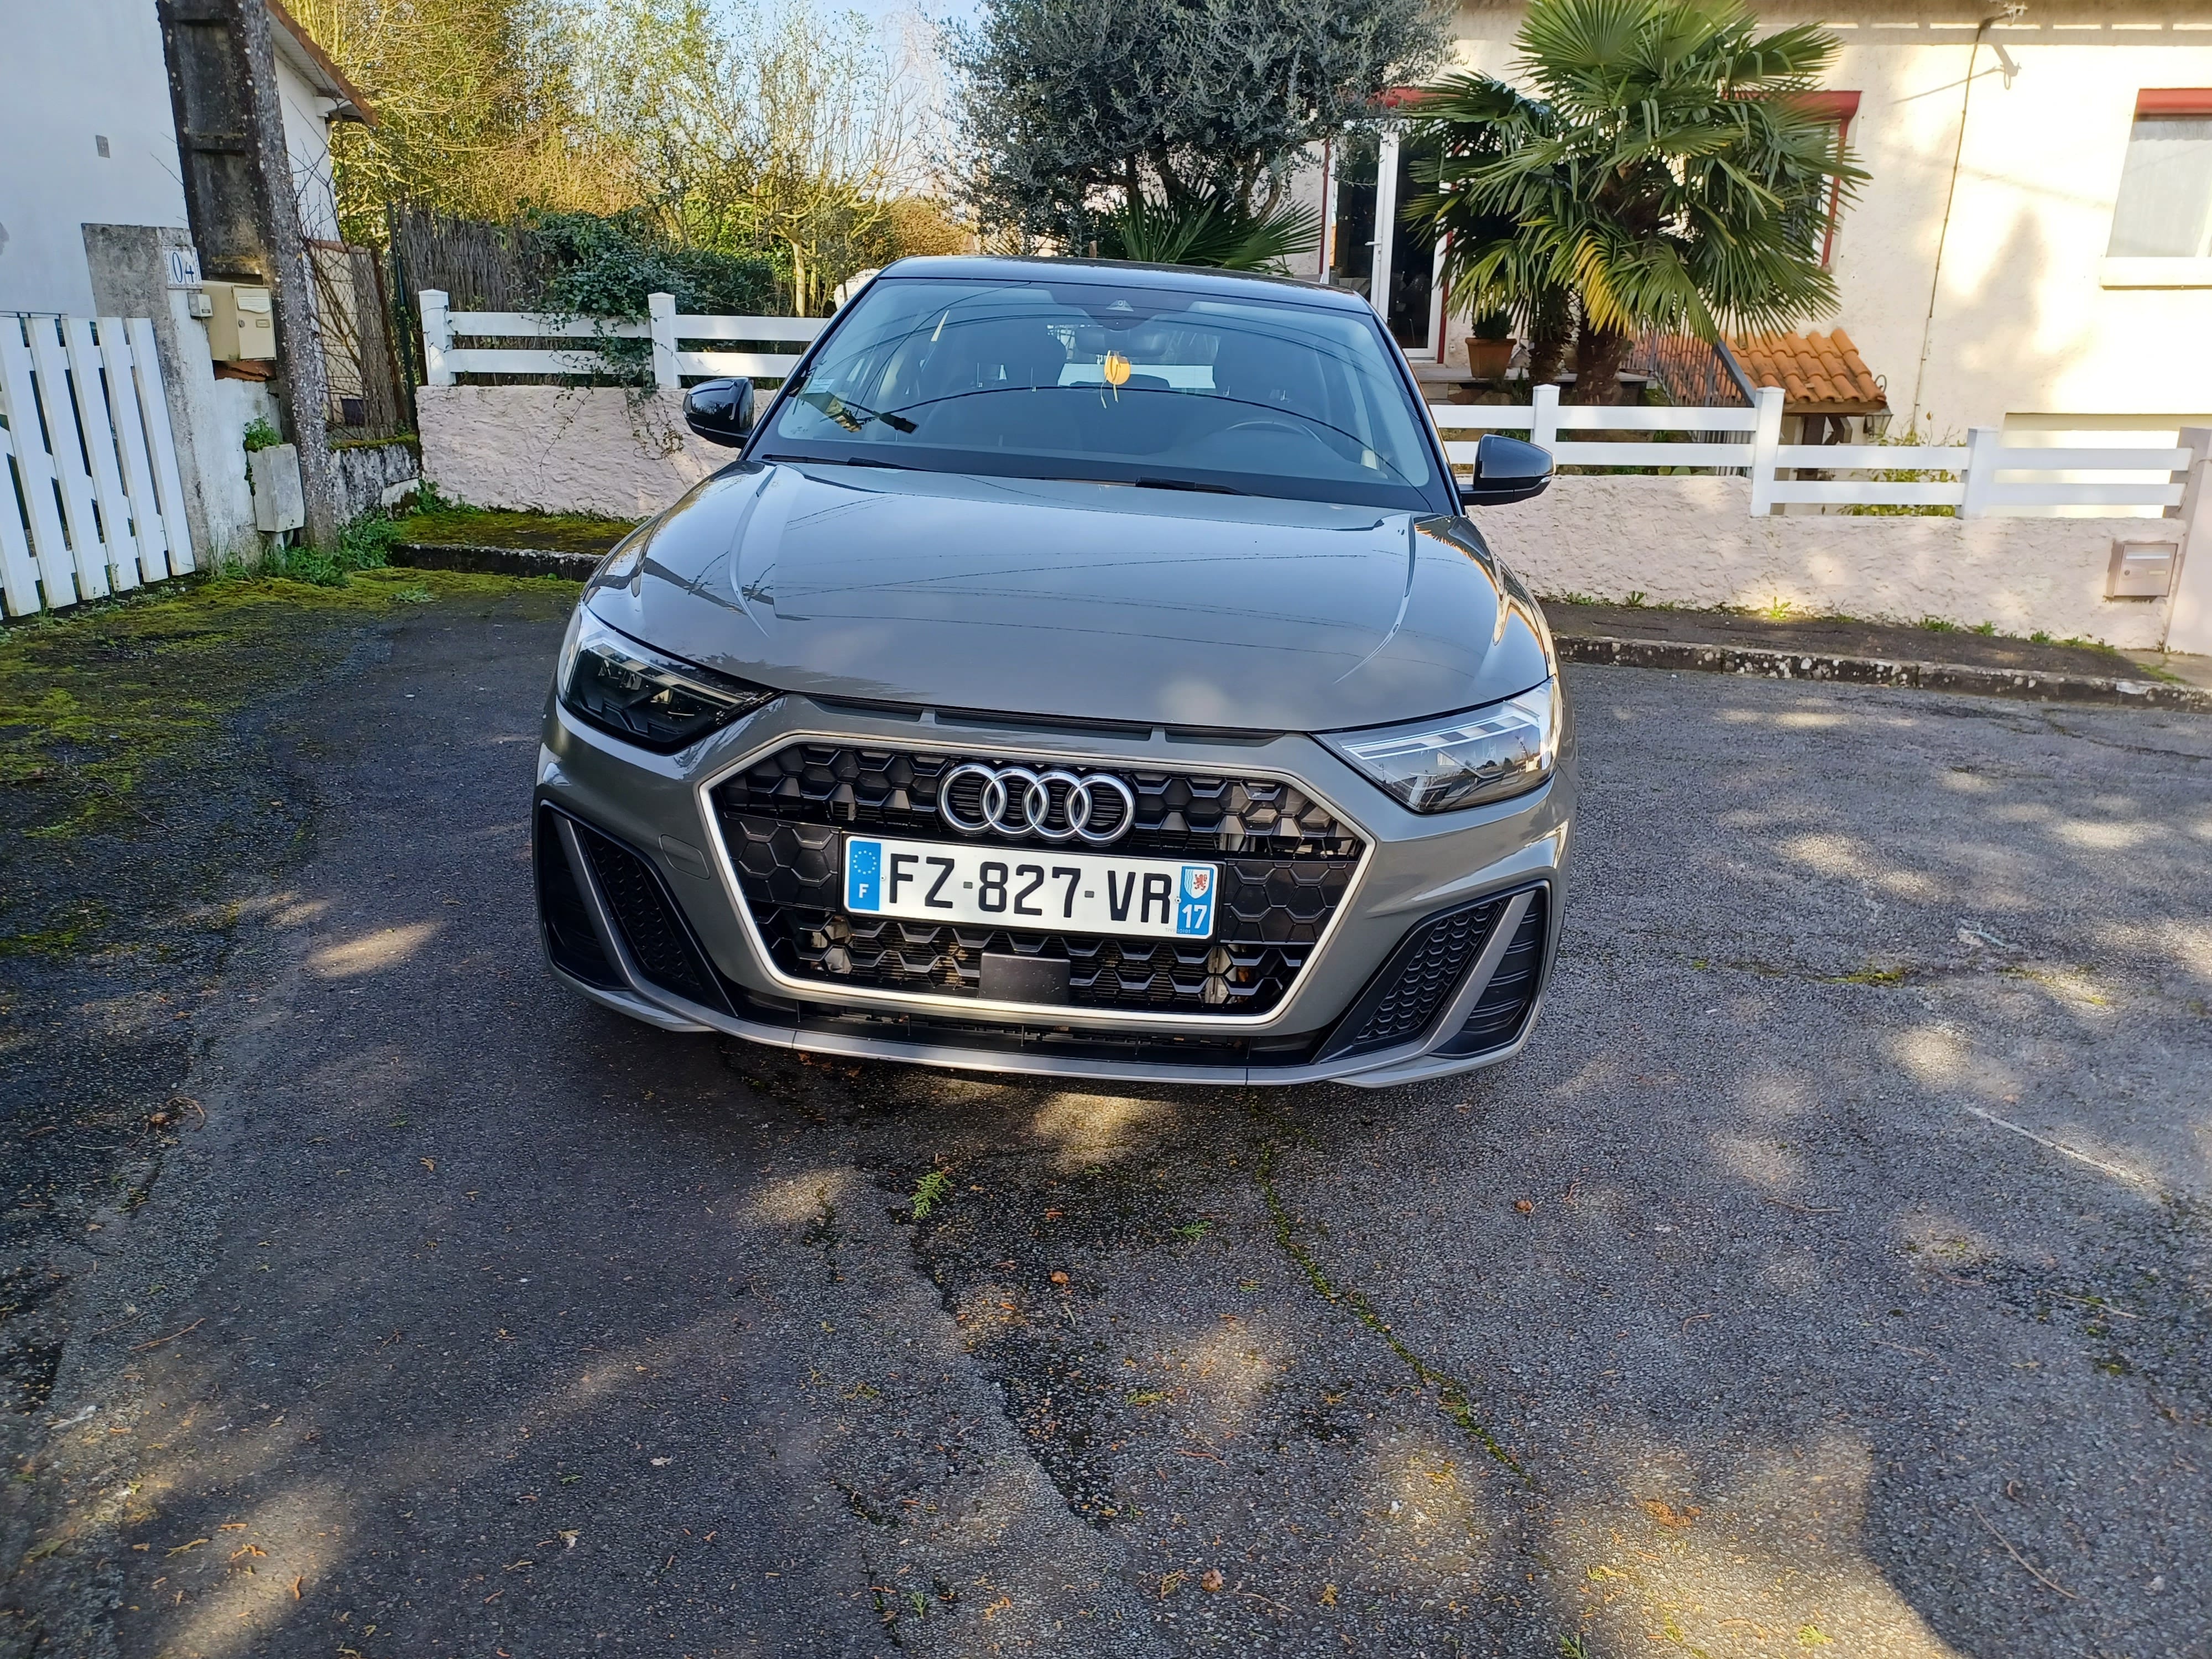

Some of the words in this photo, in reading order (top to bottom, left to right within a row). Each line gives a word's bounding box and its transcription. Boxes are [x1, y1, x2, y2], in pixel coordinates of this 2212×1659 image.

[173, 252, 194, 283] 04
[858, 883, 869, 899] F
[1182, 904, 1207, 928] 17
